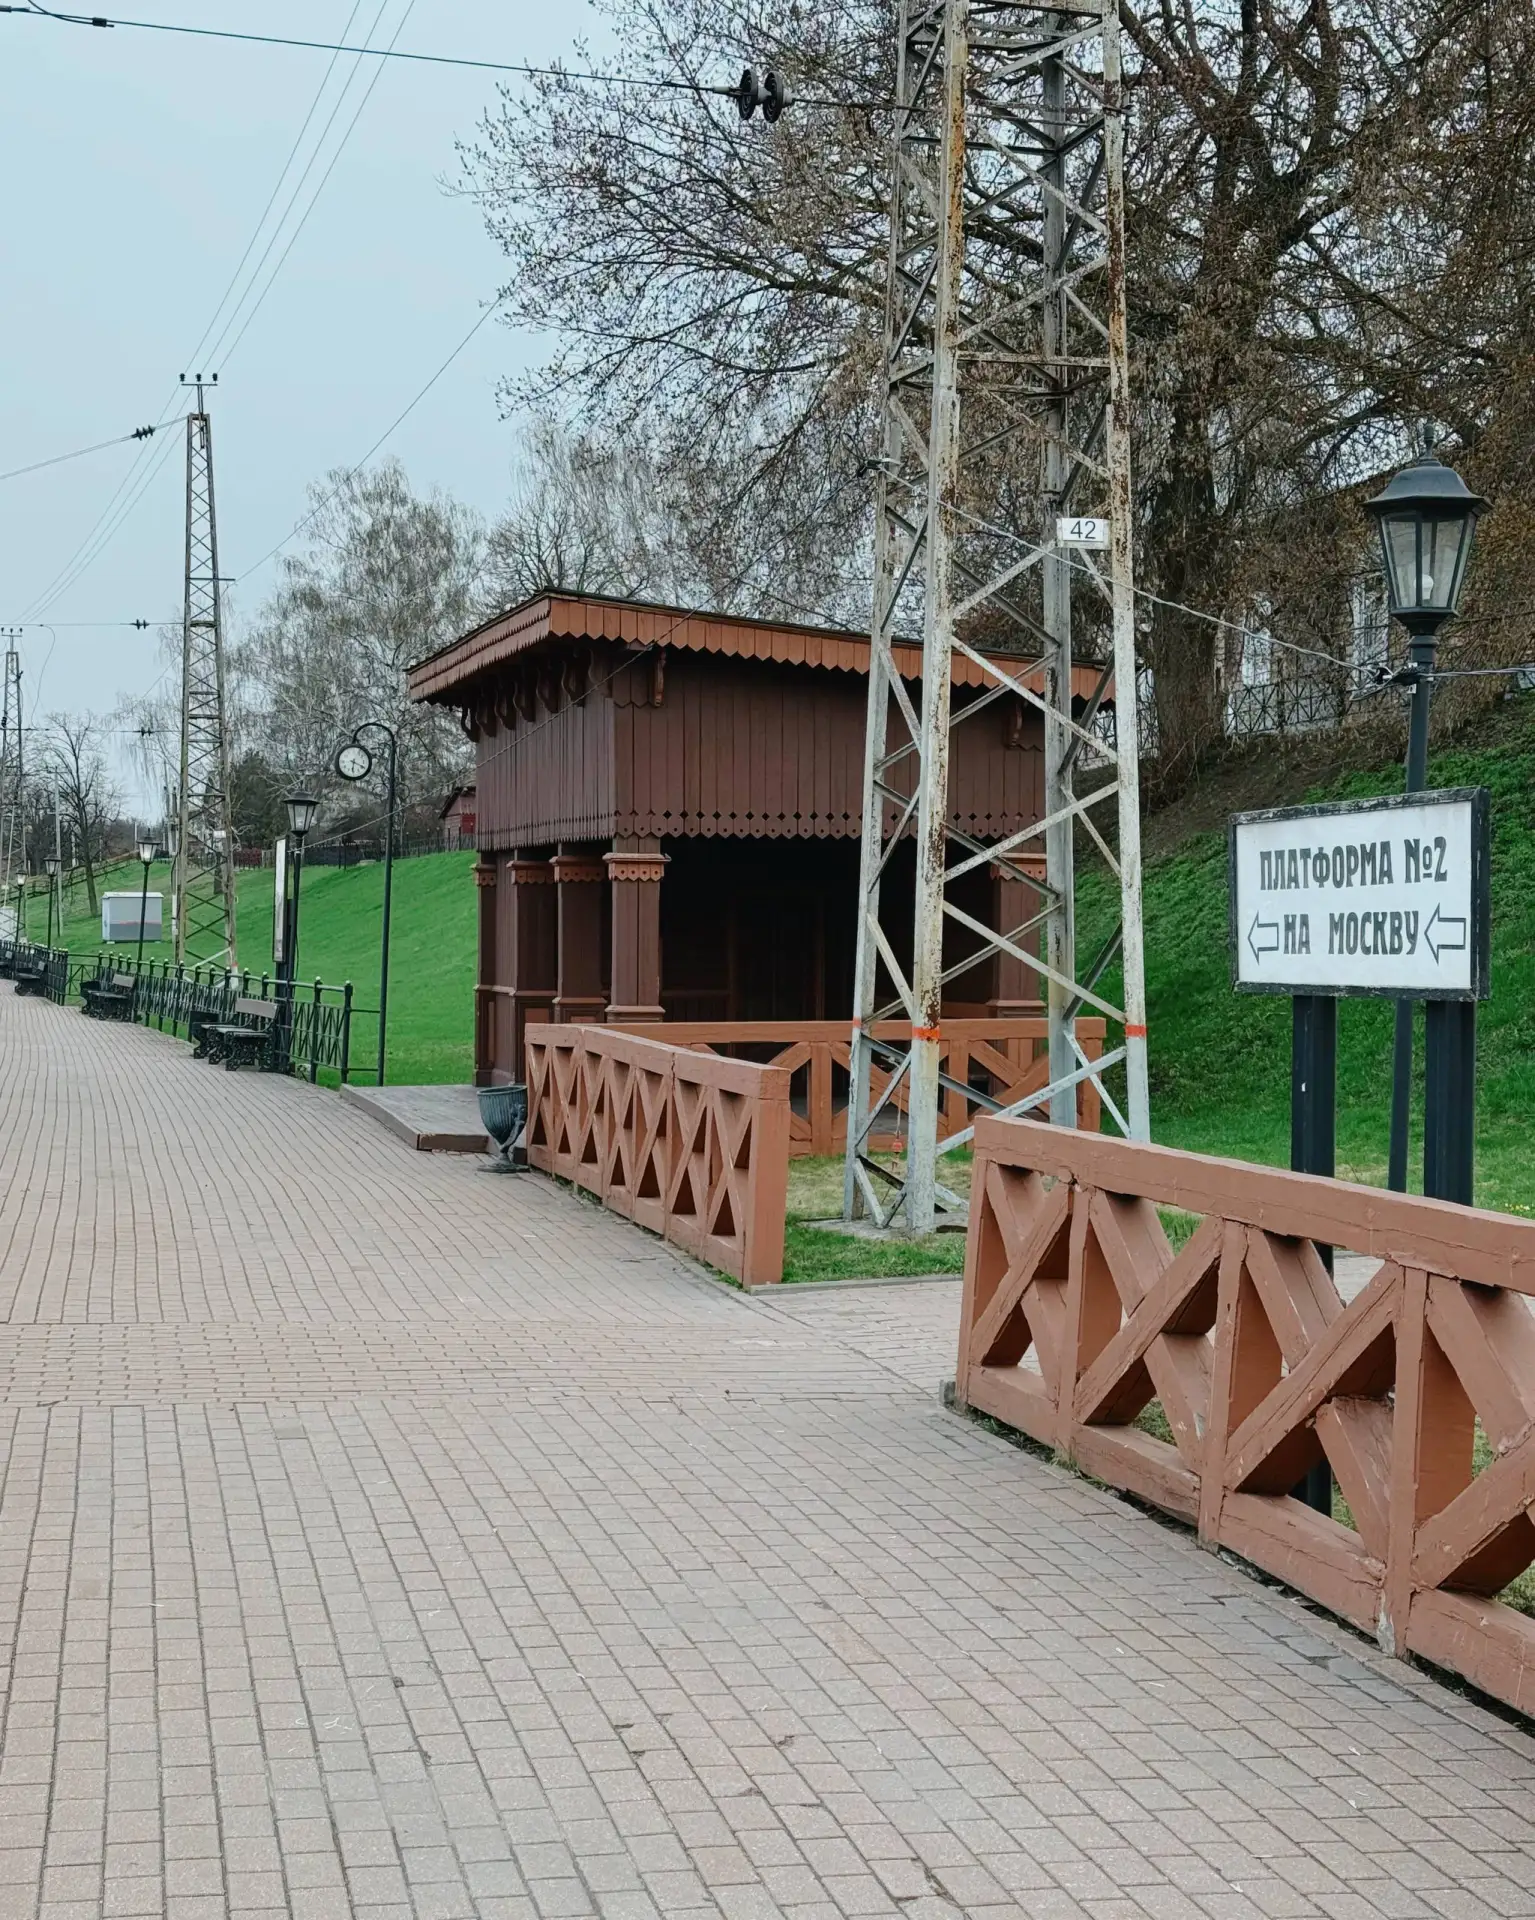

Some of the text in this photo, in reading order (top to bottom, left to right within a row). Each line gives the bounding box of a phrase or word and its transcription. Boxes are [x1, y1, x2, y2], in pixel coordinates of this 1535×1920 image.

[1070, 520, 1096, 540] 42
[1259, 840, 1394, 890] ПЛАТФОРМА
[1283, 910, 1419, 955] НА МОСКВУ
